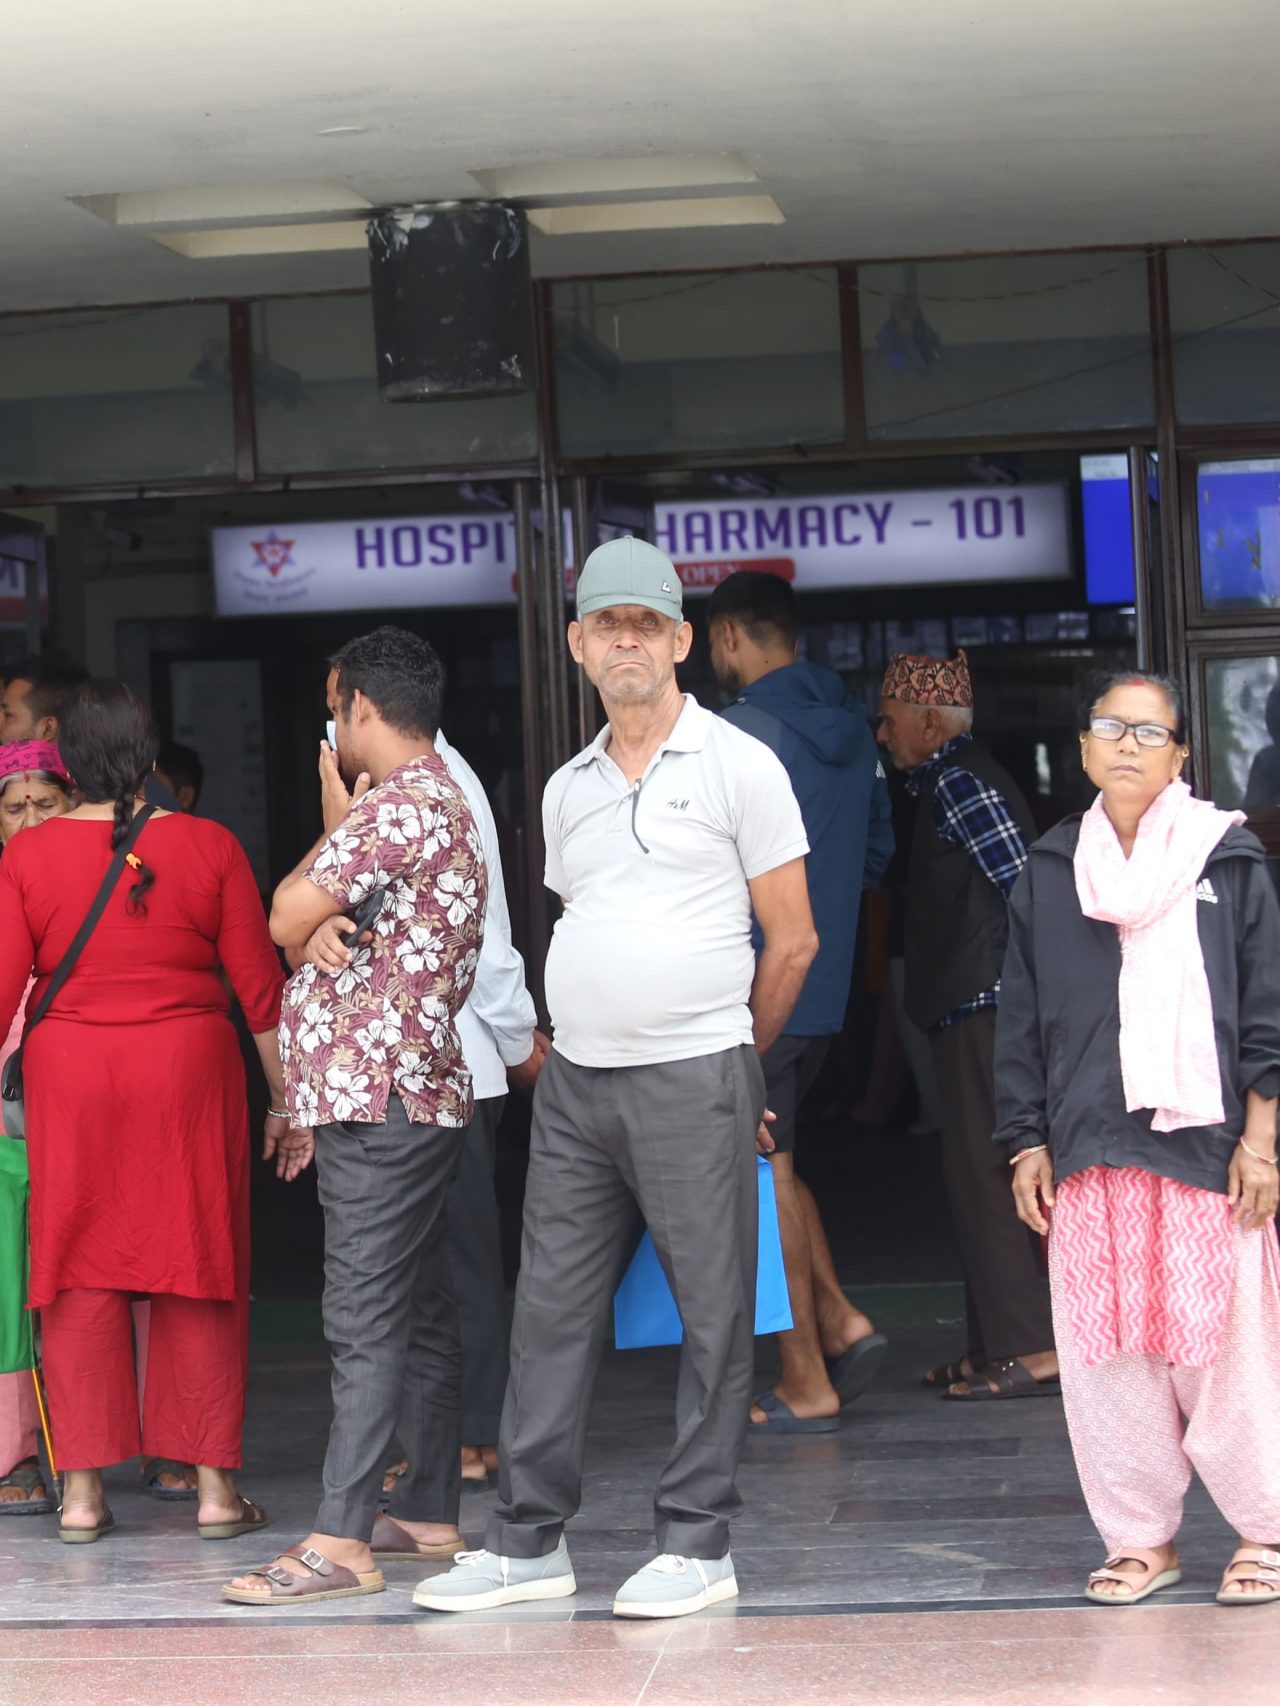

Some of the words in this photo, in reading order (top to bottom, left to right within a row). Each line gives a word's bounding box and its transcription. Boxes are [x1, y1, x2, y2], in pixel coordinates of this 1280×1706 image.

[355, 520, 568, 569] HOSPI
[655, 500, 893, 554] HARMACY
[949, 495, 1025, 541] 101
